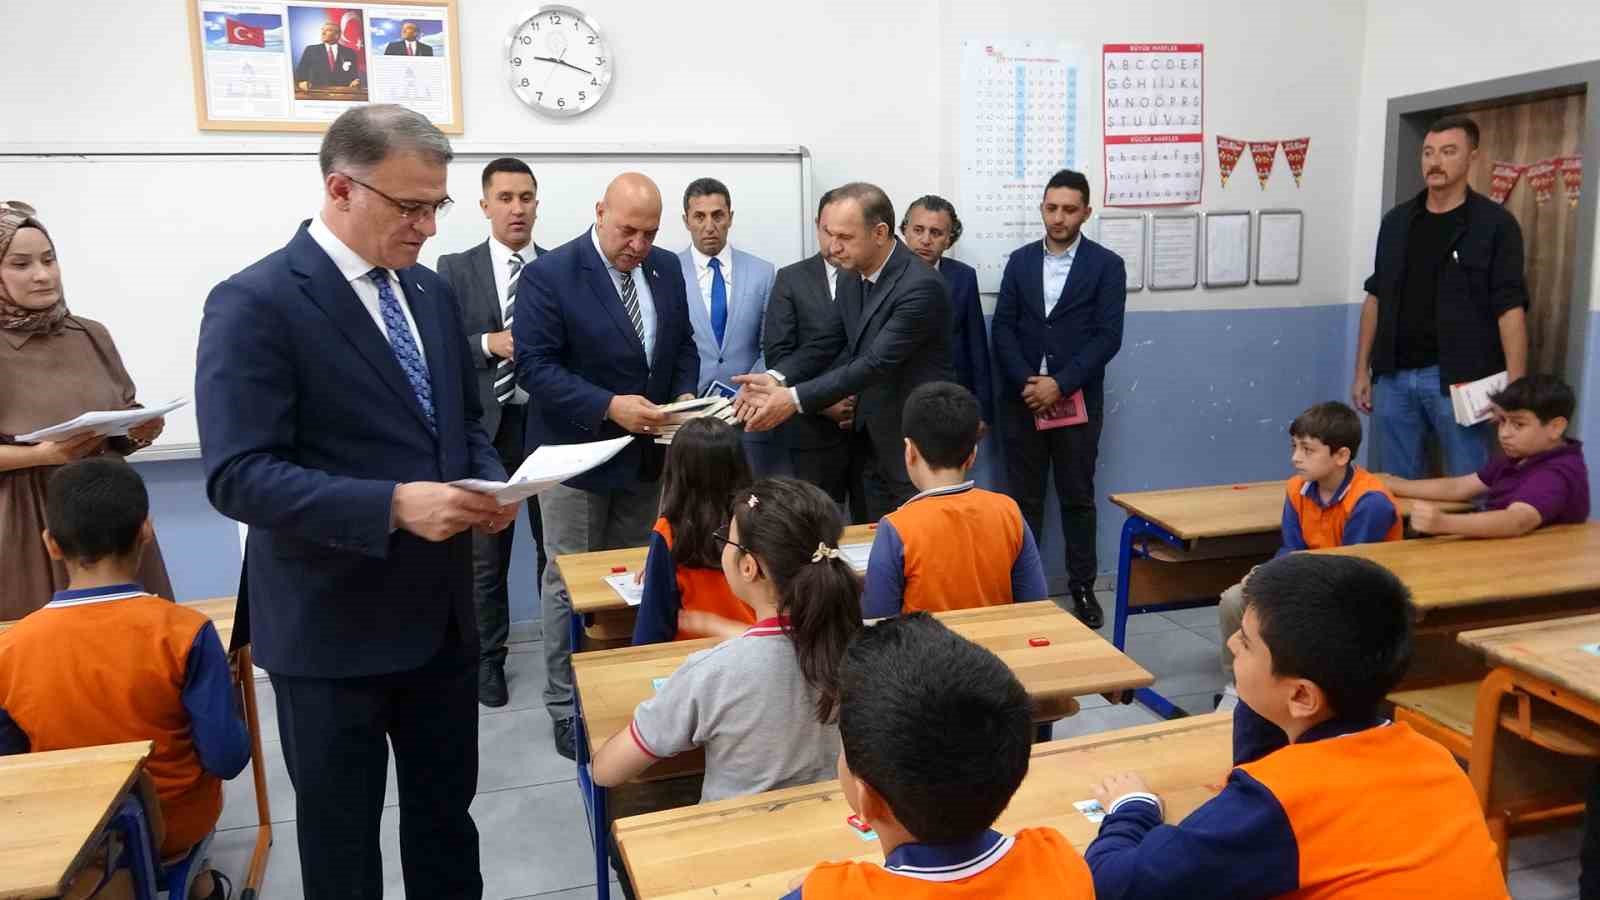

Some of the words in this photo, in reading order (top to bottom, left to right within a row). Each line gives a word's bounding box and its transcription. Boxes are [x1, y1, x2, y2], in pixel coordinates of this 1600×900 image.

[549, 15, 561, 25] 12
[531, 22, 539, 31] 11
[574, 22, 578, 31] 1
[519, 35, 532, 45] 10
[586, 35, 595, 45] 2
[513, 57, 522, 66] 9
[595, 56, 602, 66] 3
[1108, 60, 1116, 70] A
[1122, 59, 1129, 70] B
[1136, 59, 1144, 70] C
[1167, 59, 1175, 70] D
[1180, 59, 1187, 70] E
[1193, 59, 1199, 69] F
[521, 78, 530, 87] 8
[590, 77, 598, 86] 4
[1107, 79, 1118, 89] G
[1137, 79, 1146, 88] H
[1181, 79, 1188, 88] K
[1192, 78, 1199, 88] L
[535, 91, 543, 101] 7
[578, 90, 586, 101] 5
[557, 97, 565, 107] 6
[1108, 97, 1119, 108] M
[1126, 97, 1134, 108] N
[1140, 97, 1150, 108] O
[1134, 115, 1142, 126] U
[1164, 114, 1172, 126] V
